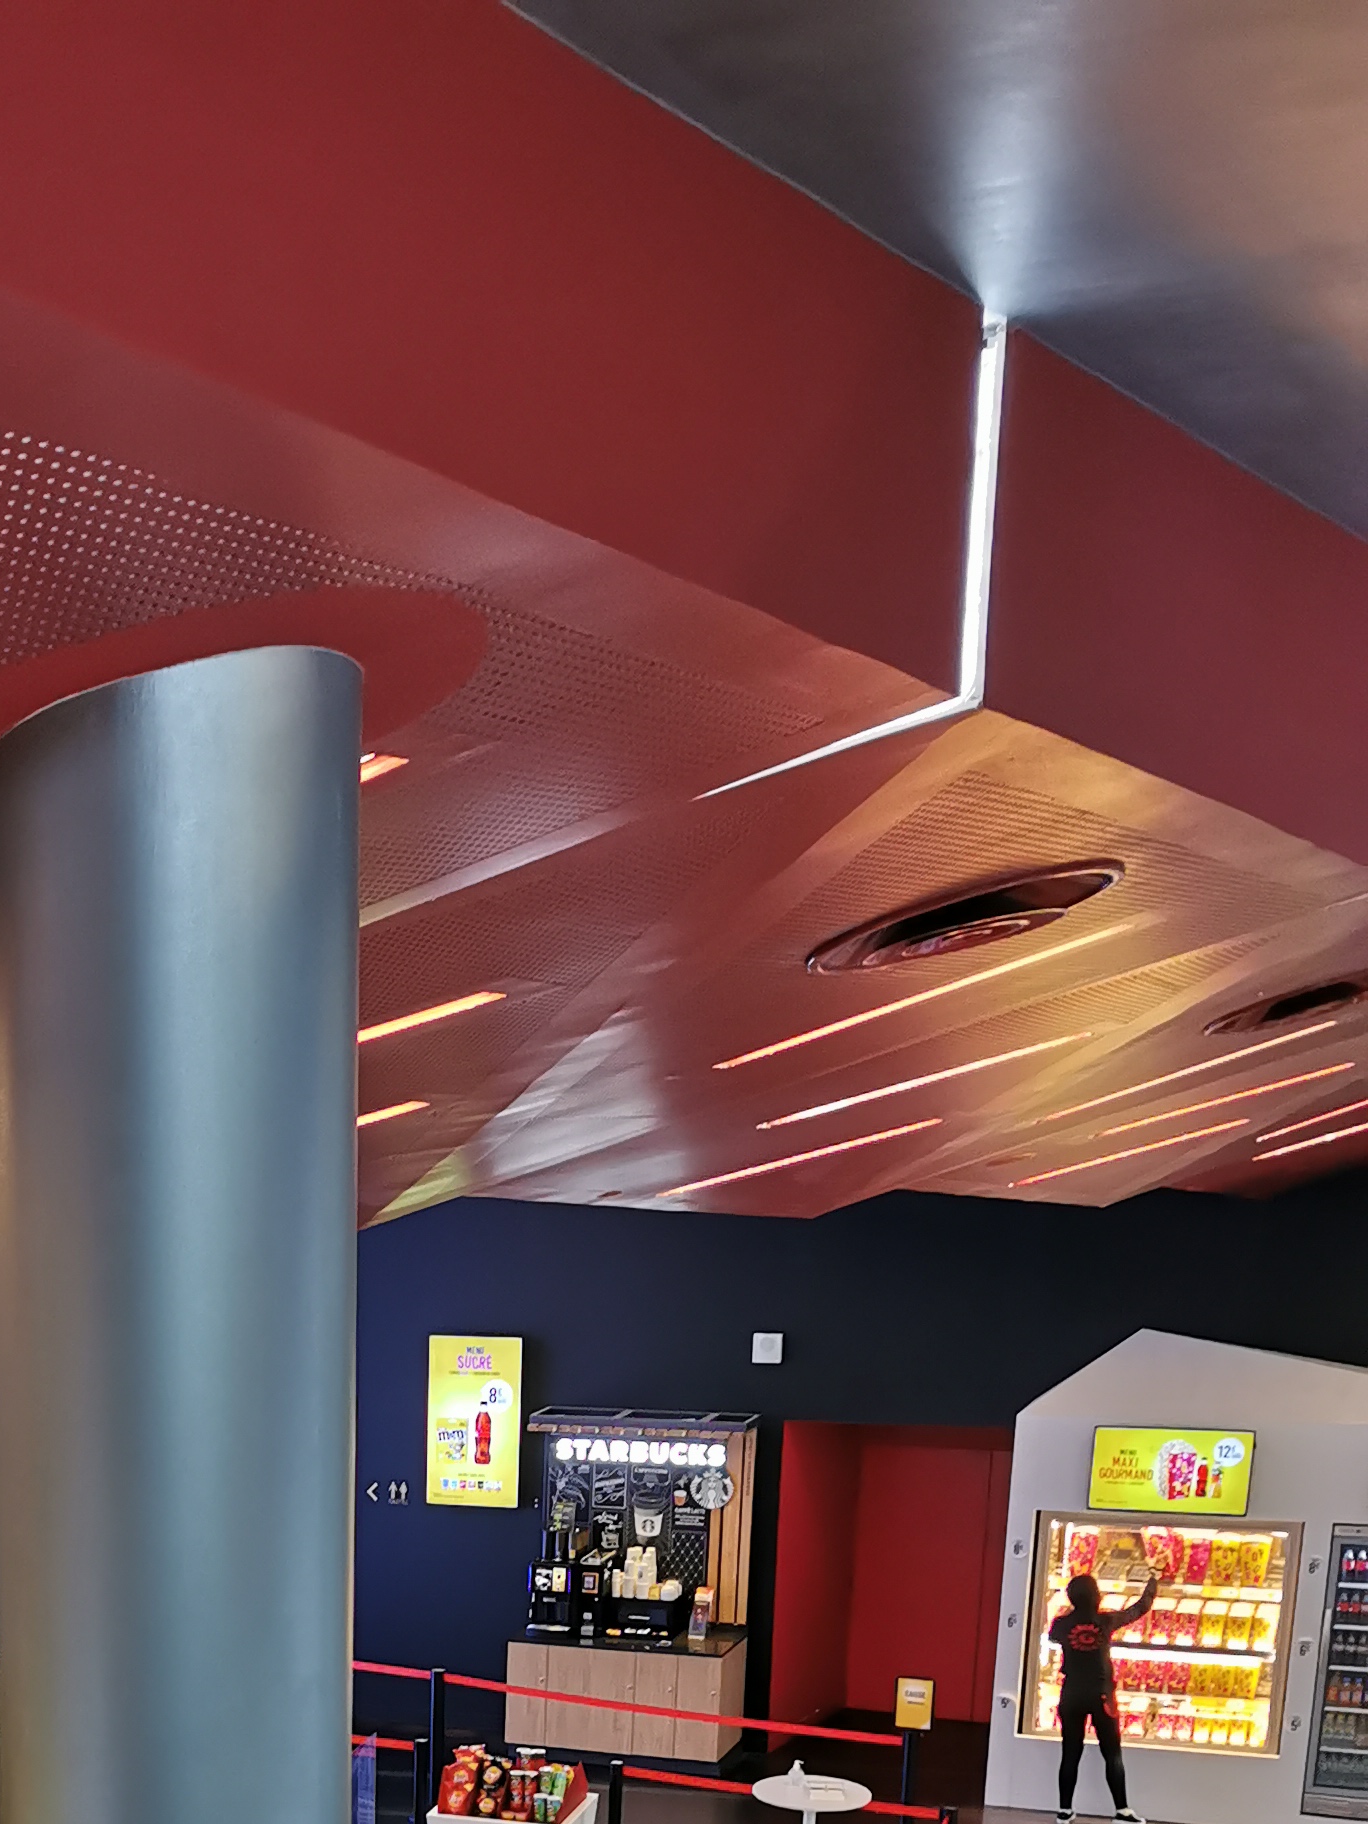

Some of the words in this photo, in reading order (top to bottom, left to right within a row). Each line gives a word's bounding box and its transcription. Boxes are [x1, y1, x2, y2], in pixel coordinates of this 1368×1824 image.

[457, 1354, 493, 1370] SUCRÉ
[555, 1438, 727, 1467] STARBUCKS
[1112, 1457, 1139, 1468] MAXI
[1098, 1467, 1154, 1482] GOURMAND
